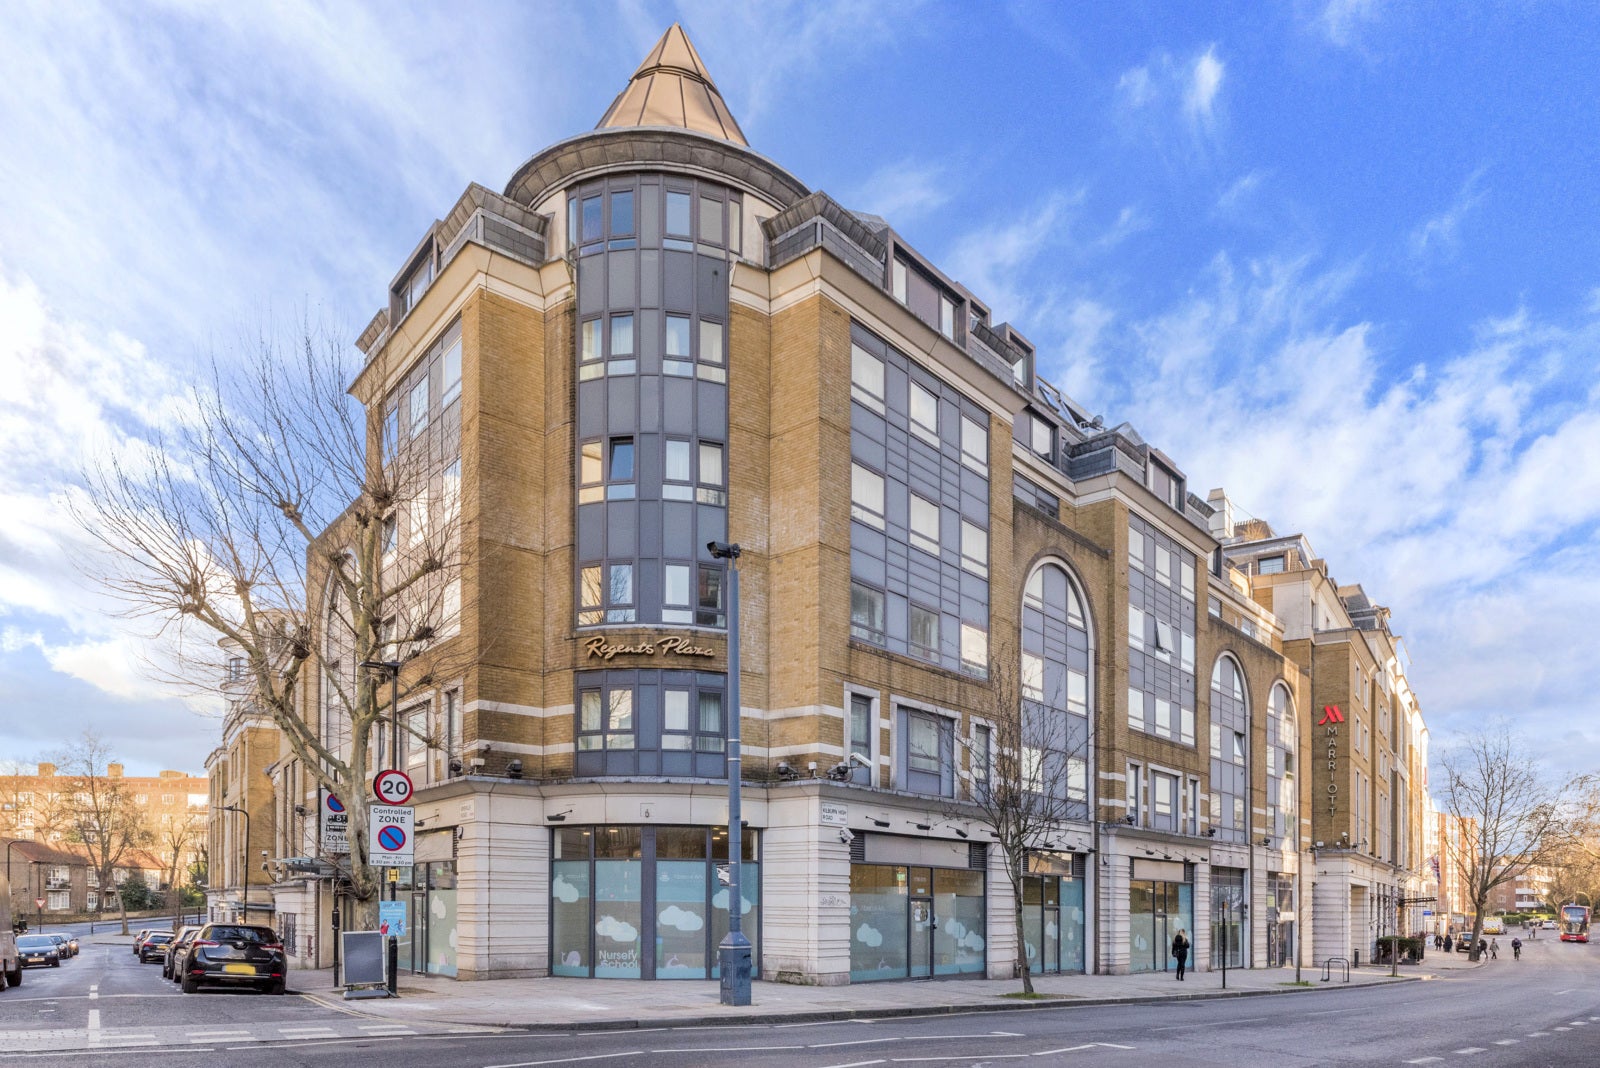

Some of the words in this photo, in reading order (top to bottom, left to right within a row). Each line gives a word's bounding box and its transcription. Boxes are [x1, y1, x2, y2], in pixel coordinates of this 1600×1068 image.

[584, 635, 655, 661] Regents
[657, 635, 716, 657] Plaza
[1327, 726, 1338, 817] MARRIOTT
[382, 780, 408, 795] 20
[373, 807, 412, 816] Controlled
[378, 815, 406, 824] ZONE
[389, 870, 398, 880] H
[599, 949, 637, 961] Nursery
[600, 959, 638, 968] School
